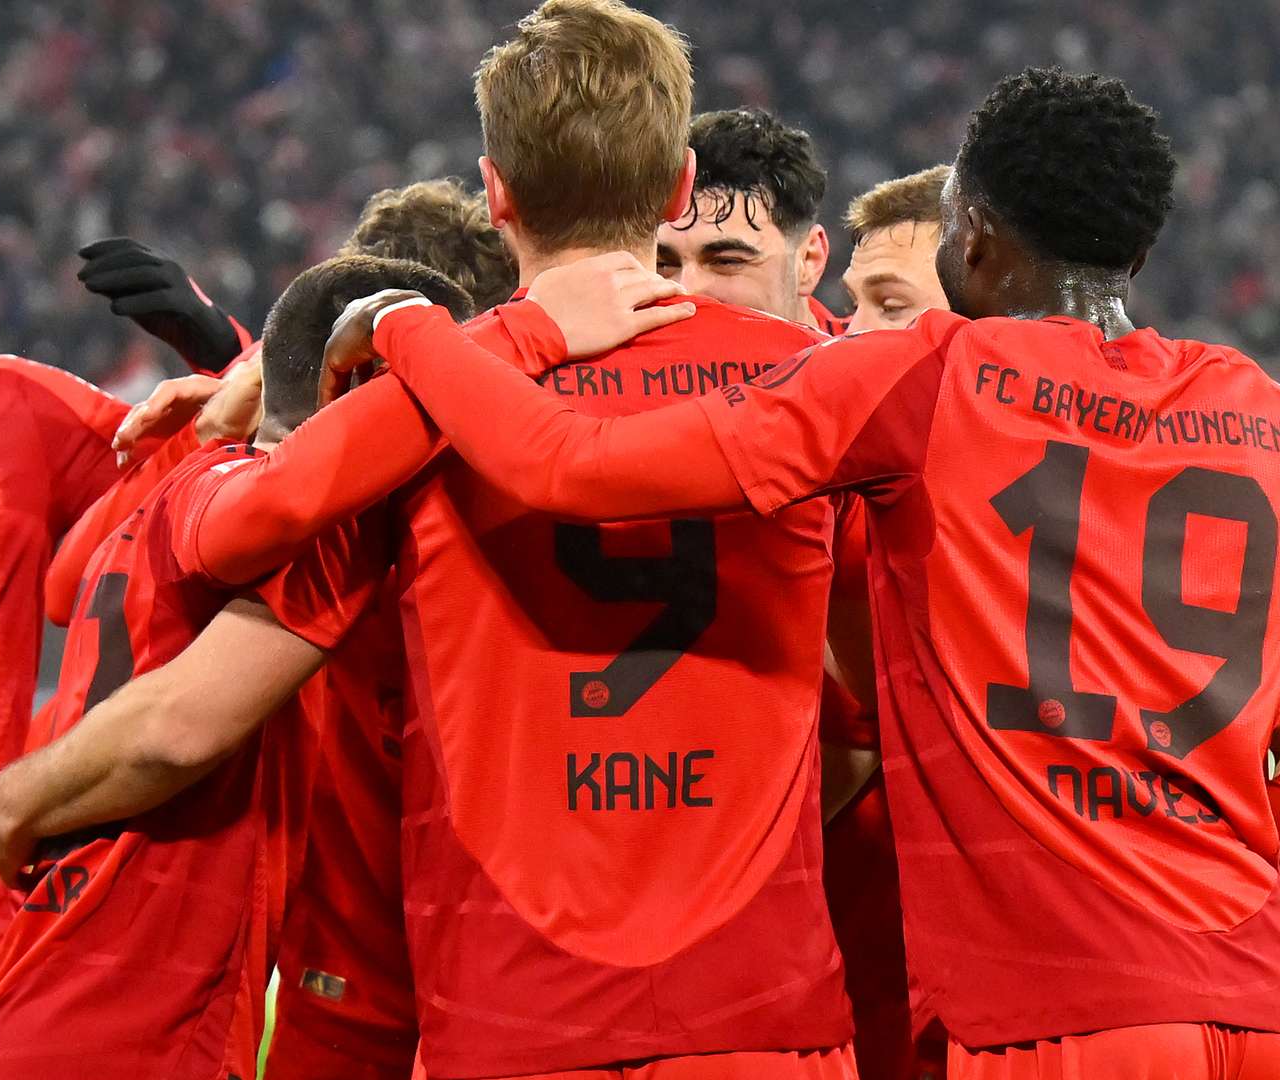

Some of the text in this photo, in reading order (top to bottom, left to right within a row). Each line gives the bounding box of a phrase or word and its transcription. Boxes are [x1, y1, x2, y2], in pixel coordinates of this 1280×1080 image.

[975, 362, 1021, 405] FC
[1032, 376, 1153, 442] BAYERN
[554, 517, 718, 718] 9
[986, 439, 1279, 760] 19
[566, 749, 715, 812] KANE
